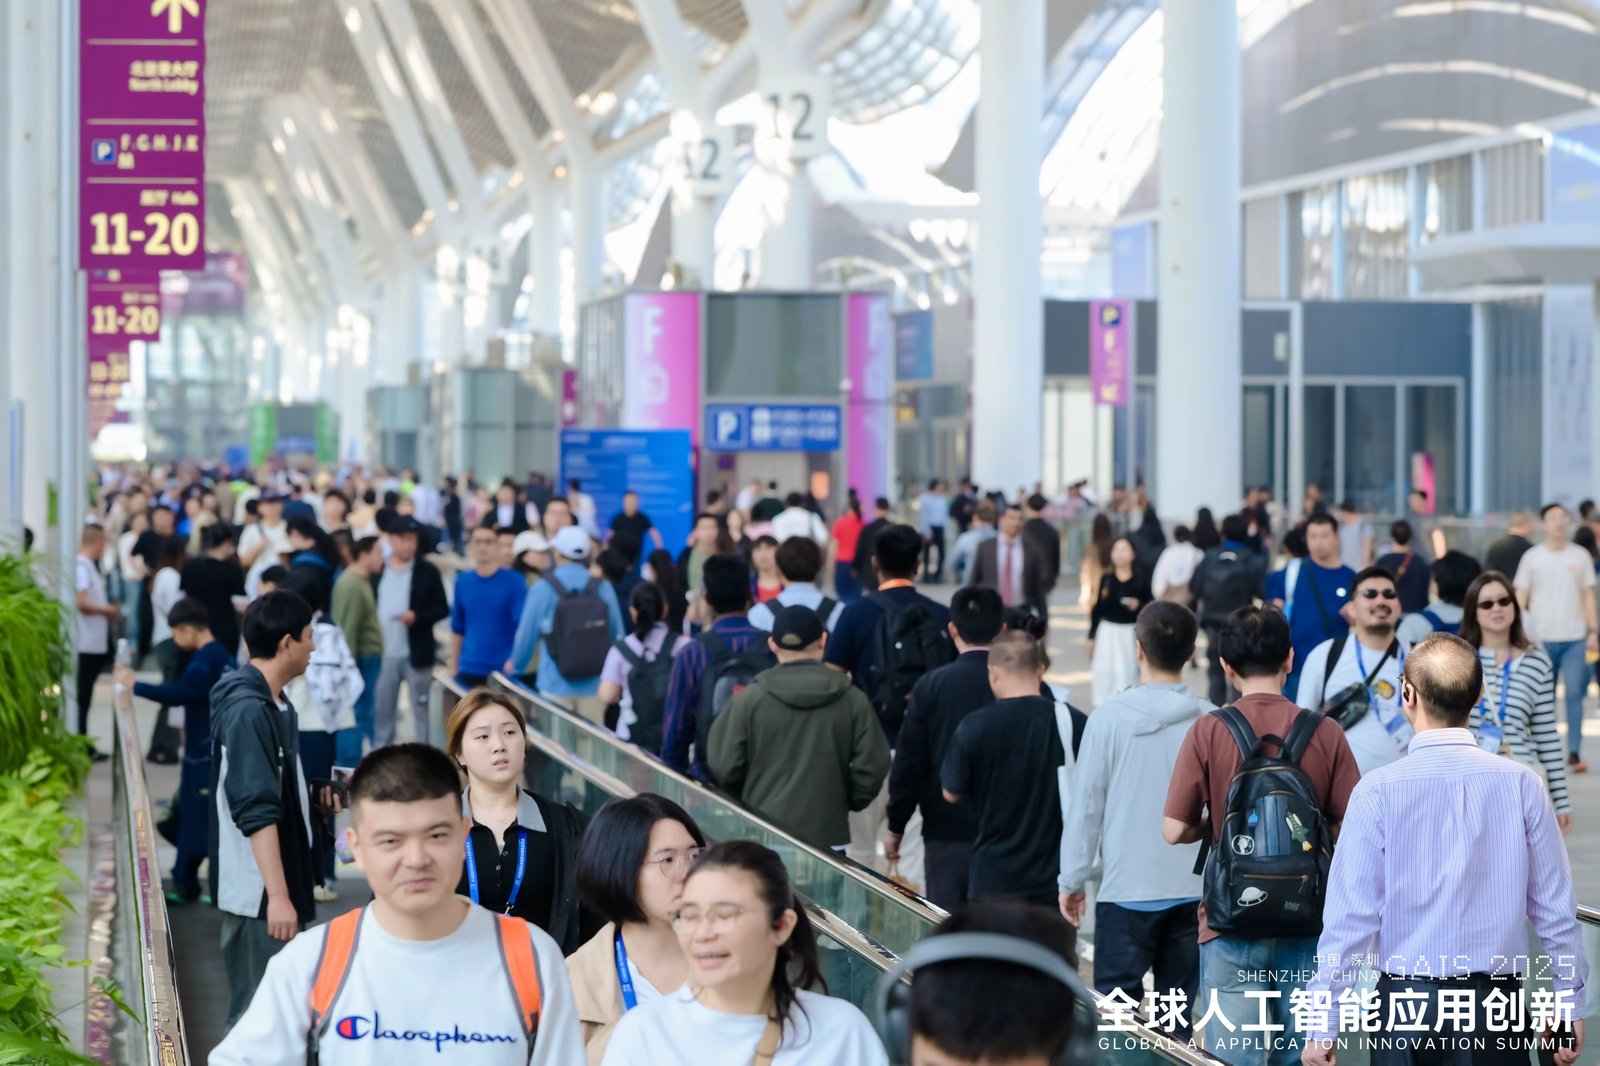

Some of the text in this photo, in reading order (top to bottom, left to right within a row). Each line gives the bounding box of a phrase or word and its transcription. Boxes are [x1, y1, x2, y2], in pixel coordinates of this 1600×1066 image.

[767, 92, 815, 141] 12
[90, 212, 200, 256] 11-20
[91, 305, 160, 335] 11-20
